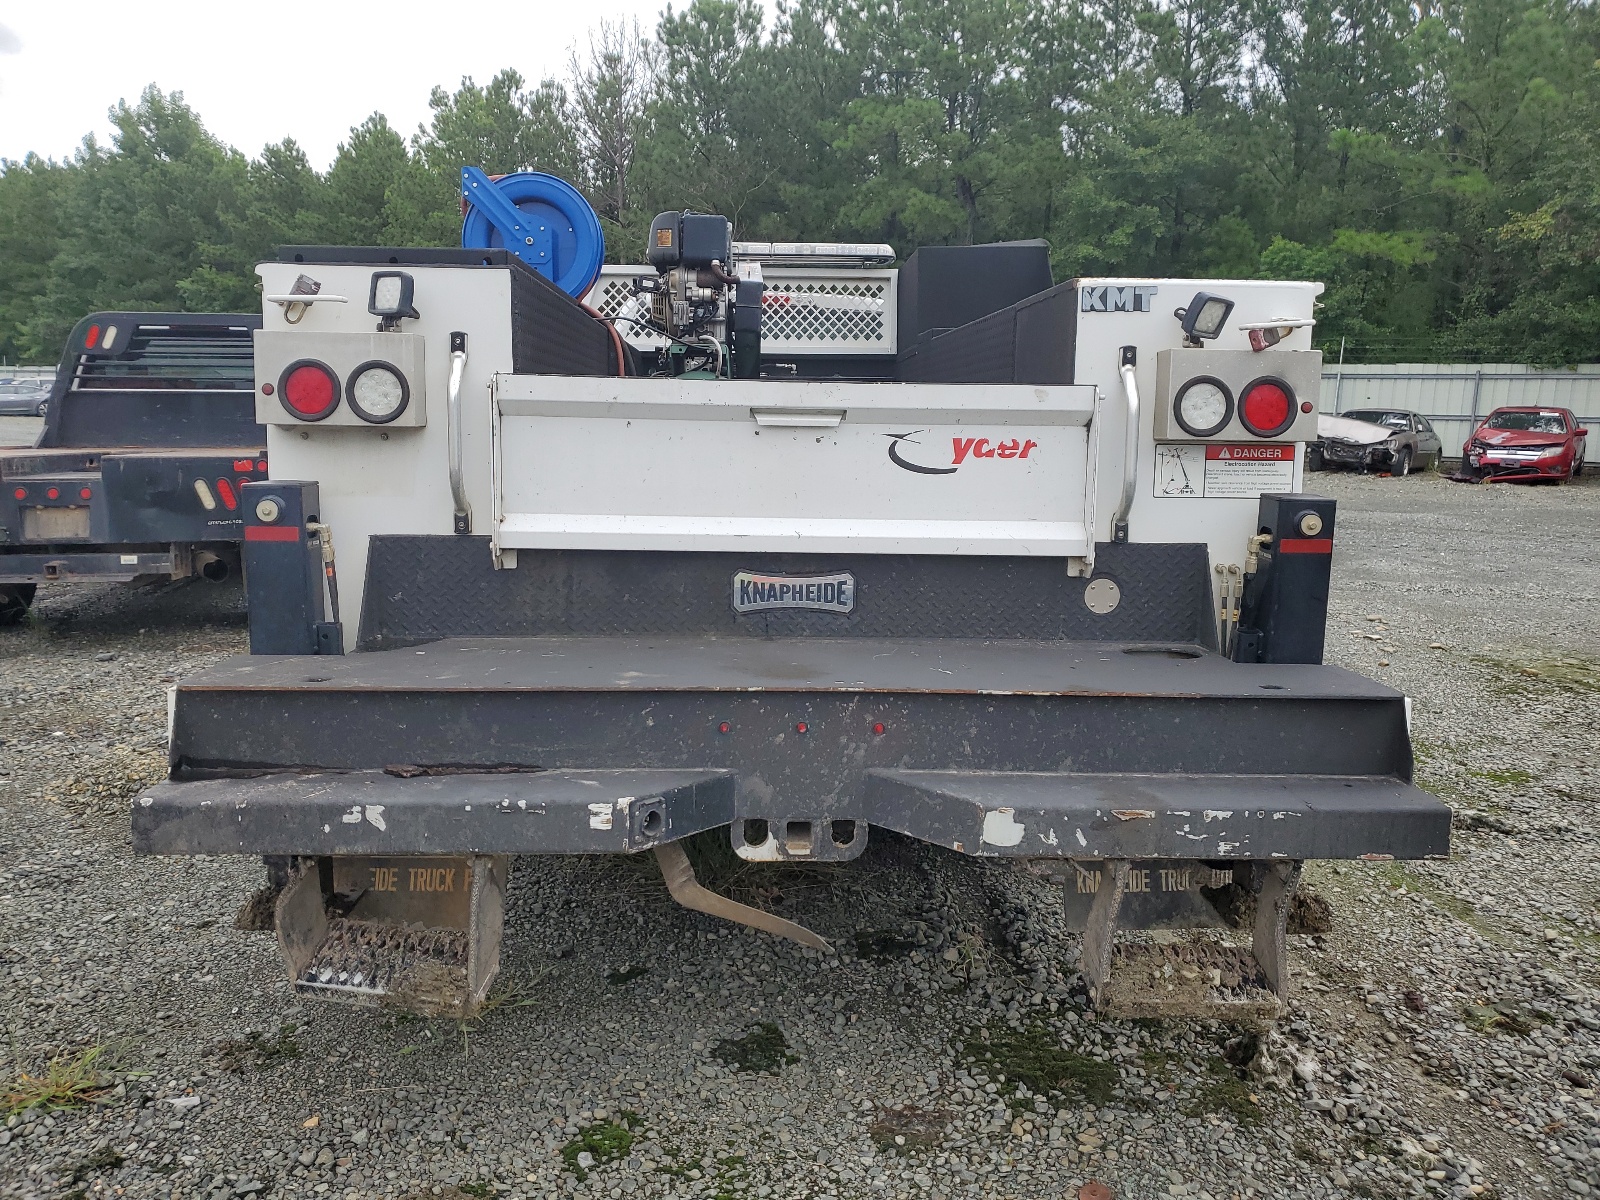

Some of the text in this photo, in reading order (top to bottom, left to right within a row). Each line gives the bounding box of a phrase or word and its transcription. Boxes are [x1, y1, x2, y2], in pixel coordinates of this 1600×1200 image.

[1081, 285, 1158, 312] KMT
[1233, 448, 1282, 458] DANGER
[739, 578, 848, 607] KNAPHEIDE
[408, 868, 456, 892] TRUCK
